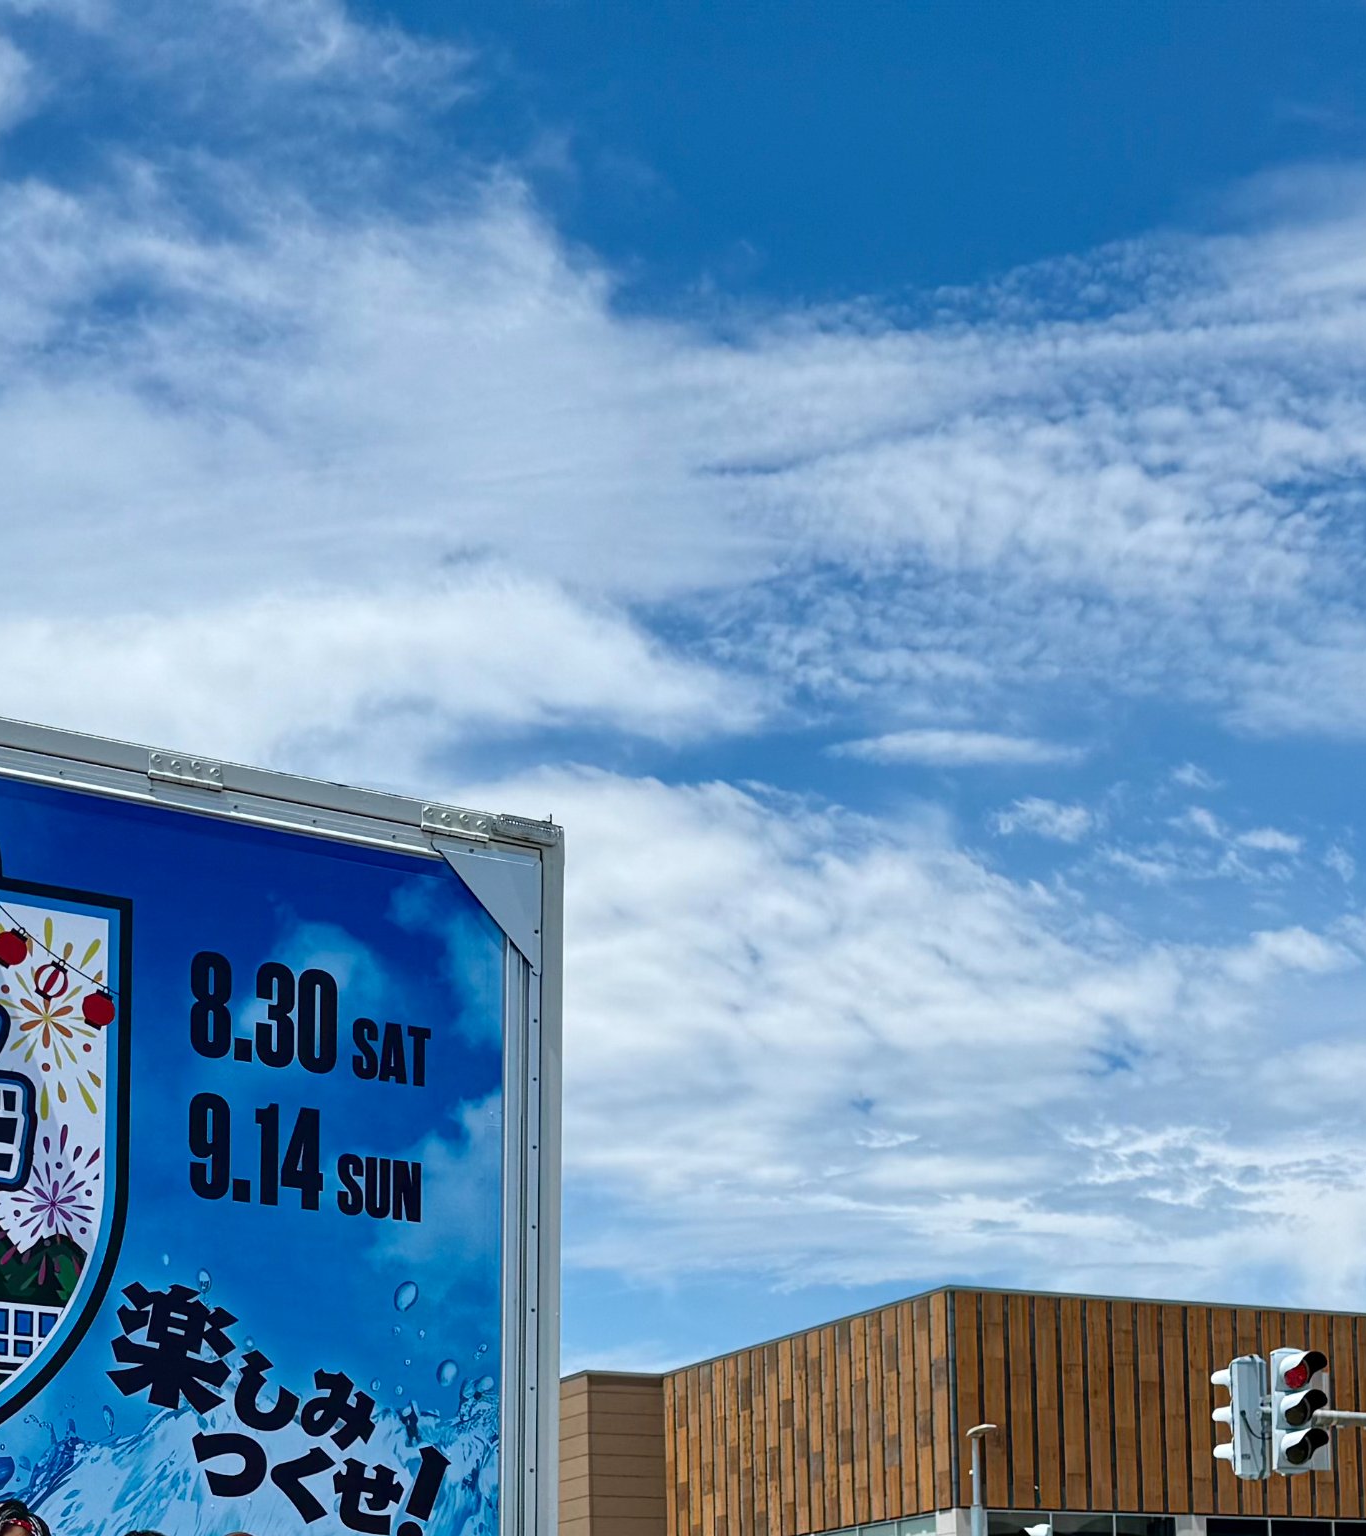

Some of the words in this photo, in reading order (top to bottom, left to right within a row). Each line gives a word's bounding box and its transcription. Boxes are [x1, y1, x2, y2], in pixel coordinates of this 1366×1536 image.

[189, 951, 338, 1074] 8.30
[352, 1018, 431, 1087] SAT
[188, 1092, 324, 1211] 9.14
[337, 1154, 422, 1223] SUN
[105, 1281, 376, 1451] 楽しみ
